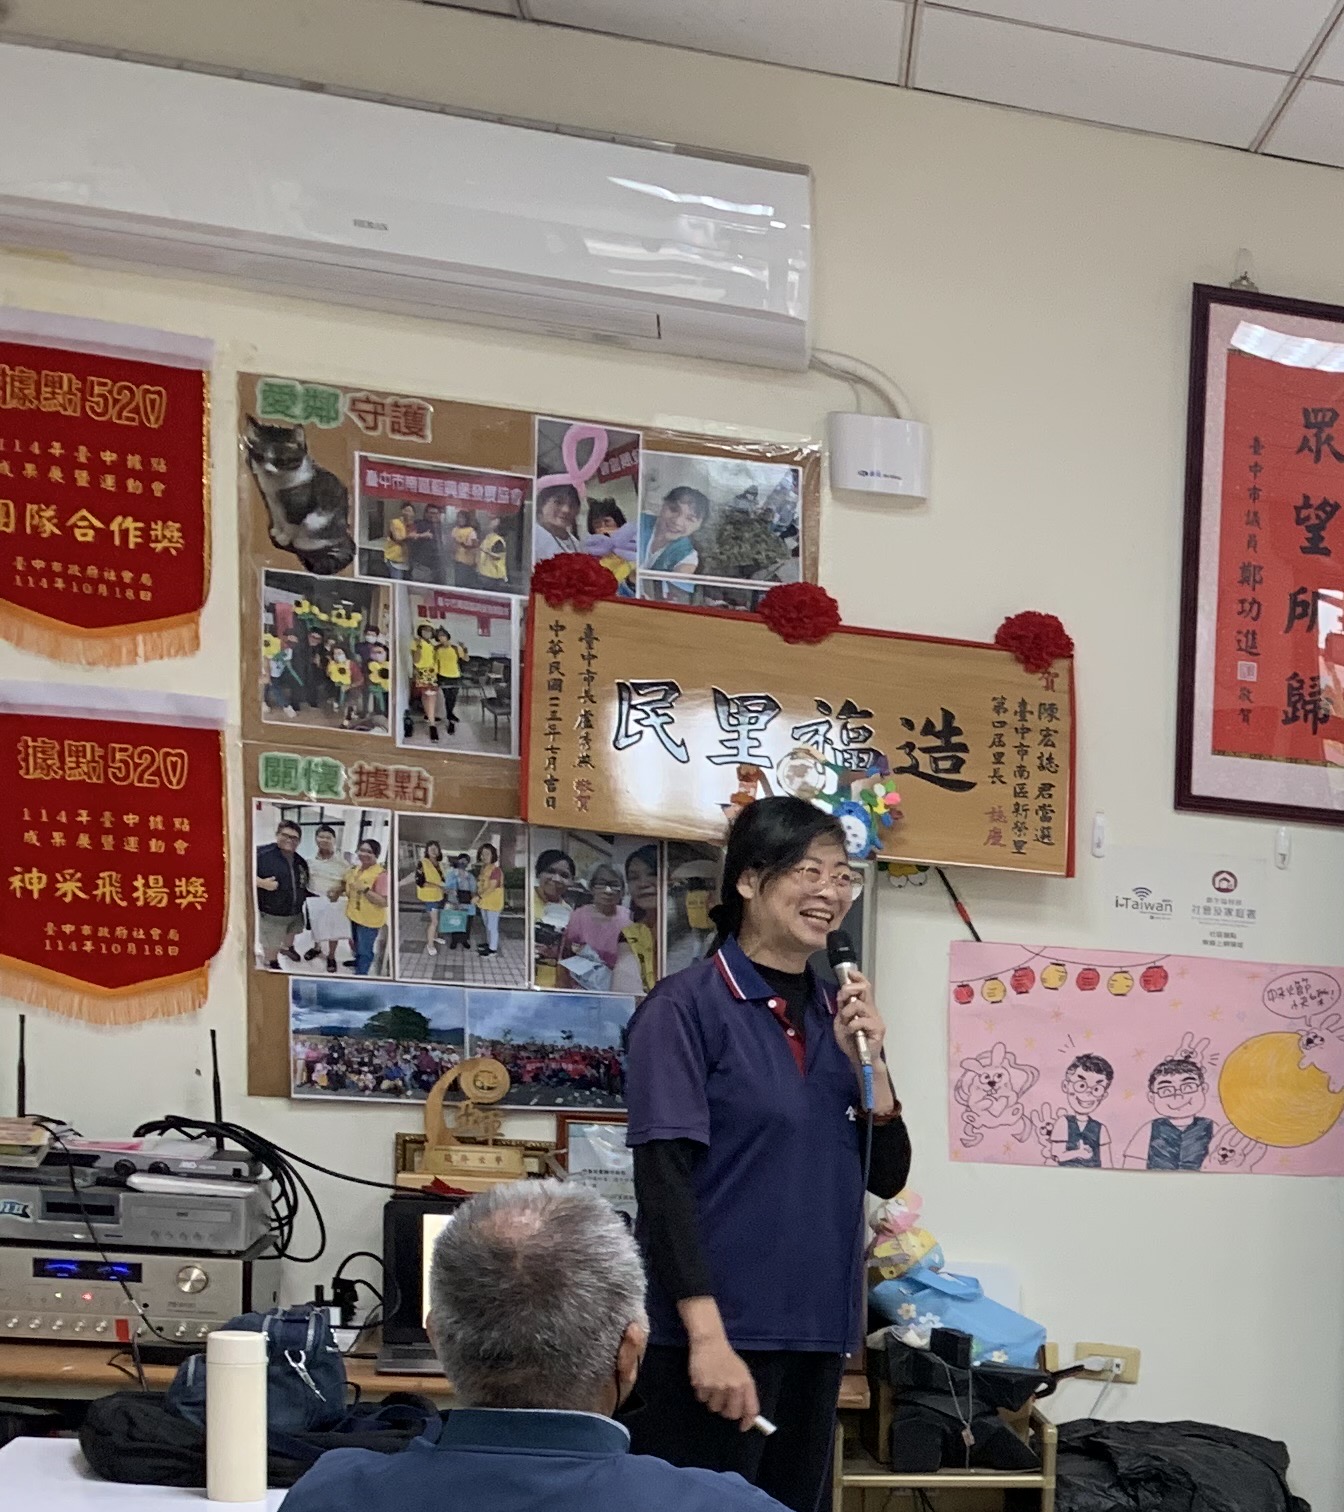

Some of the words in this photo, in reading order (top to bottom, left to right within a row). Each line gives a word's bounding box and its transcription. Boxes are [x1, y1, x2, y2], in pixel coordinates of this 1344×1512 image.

[17, 735, 189, 790] 據點520
[8, 866, 208, 911] 神采飛揚獎
